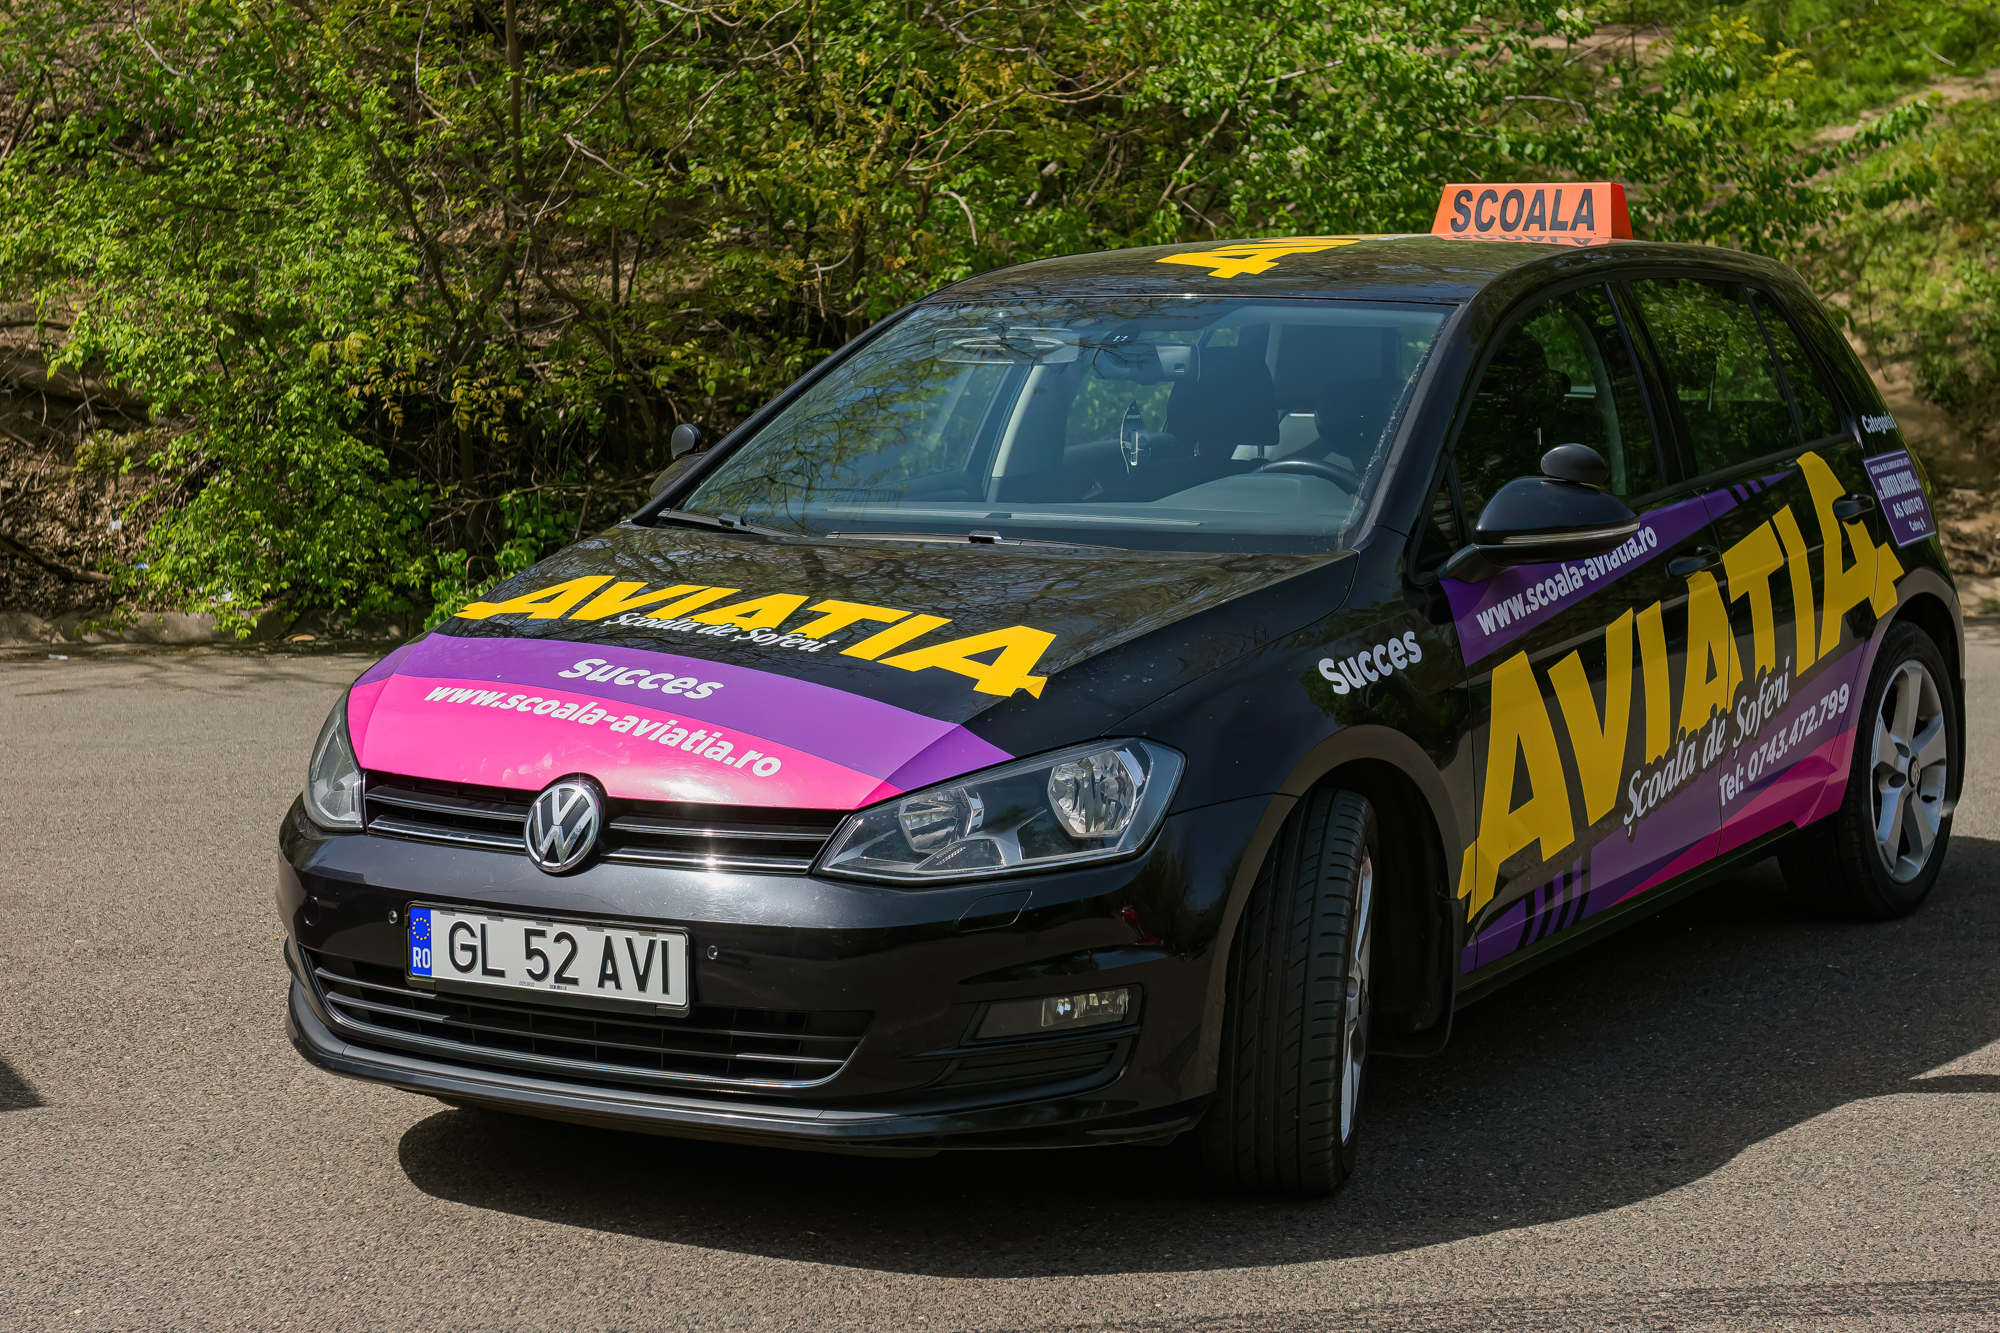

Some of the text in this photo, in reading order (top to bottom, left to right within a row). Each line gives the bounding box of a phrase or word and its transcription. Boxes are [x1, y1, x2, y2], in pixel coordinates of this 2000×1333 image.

[1450, 189, 1595, 233] SCOALA
[1475, 525, 1658, 636] www.scoala-aviatia.ro
[454, 575, 1057, 698] AVIATIA
[696, 622, 740, 637] de
[1318, 631, 1422, 695] Succes
[557, 658, 724, 700] Succes
[1457, 450, 1905, 924] AVIATIA
[424, 686, 782, 778] www.scoala-aviatia.ro
[1702, 717, 1726, 769] de
[1719, 682, 1850, 806] Tel: 0743.472.799
[412, 946, 431, 968] RO
[448, 920, 671, 995] GL 52 AVI
